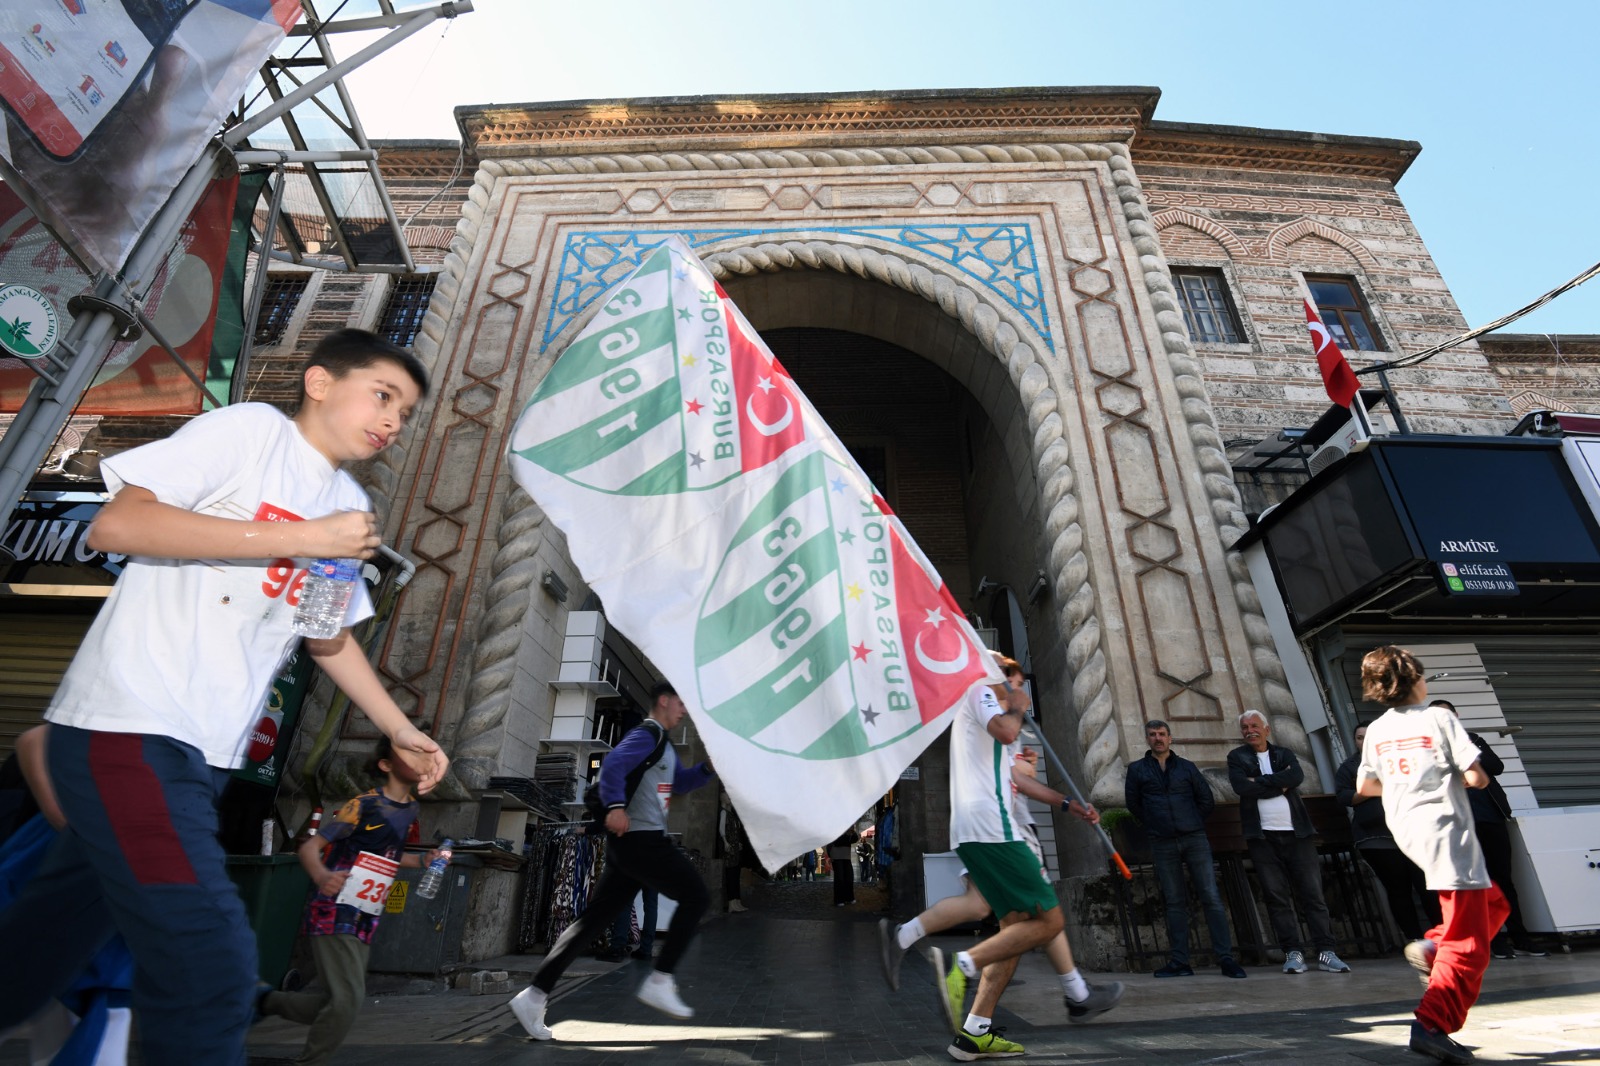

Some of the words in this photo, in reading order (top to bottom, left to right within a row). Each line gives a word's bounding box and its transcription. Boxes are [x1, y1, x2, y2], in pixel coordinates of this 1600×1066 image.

[1440, 539, 1499, 553] ARMİNE
[1459, 564, 1508, 576] eliffarah
[1464, 580, 1482, 590] 0533
[1482, 580, 1496, 590] 026
[1496, 580, 1506, 590] 10
[1506, 581, 1515, 590] 30
